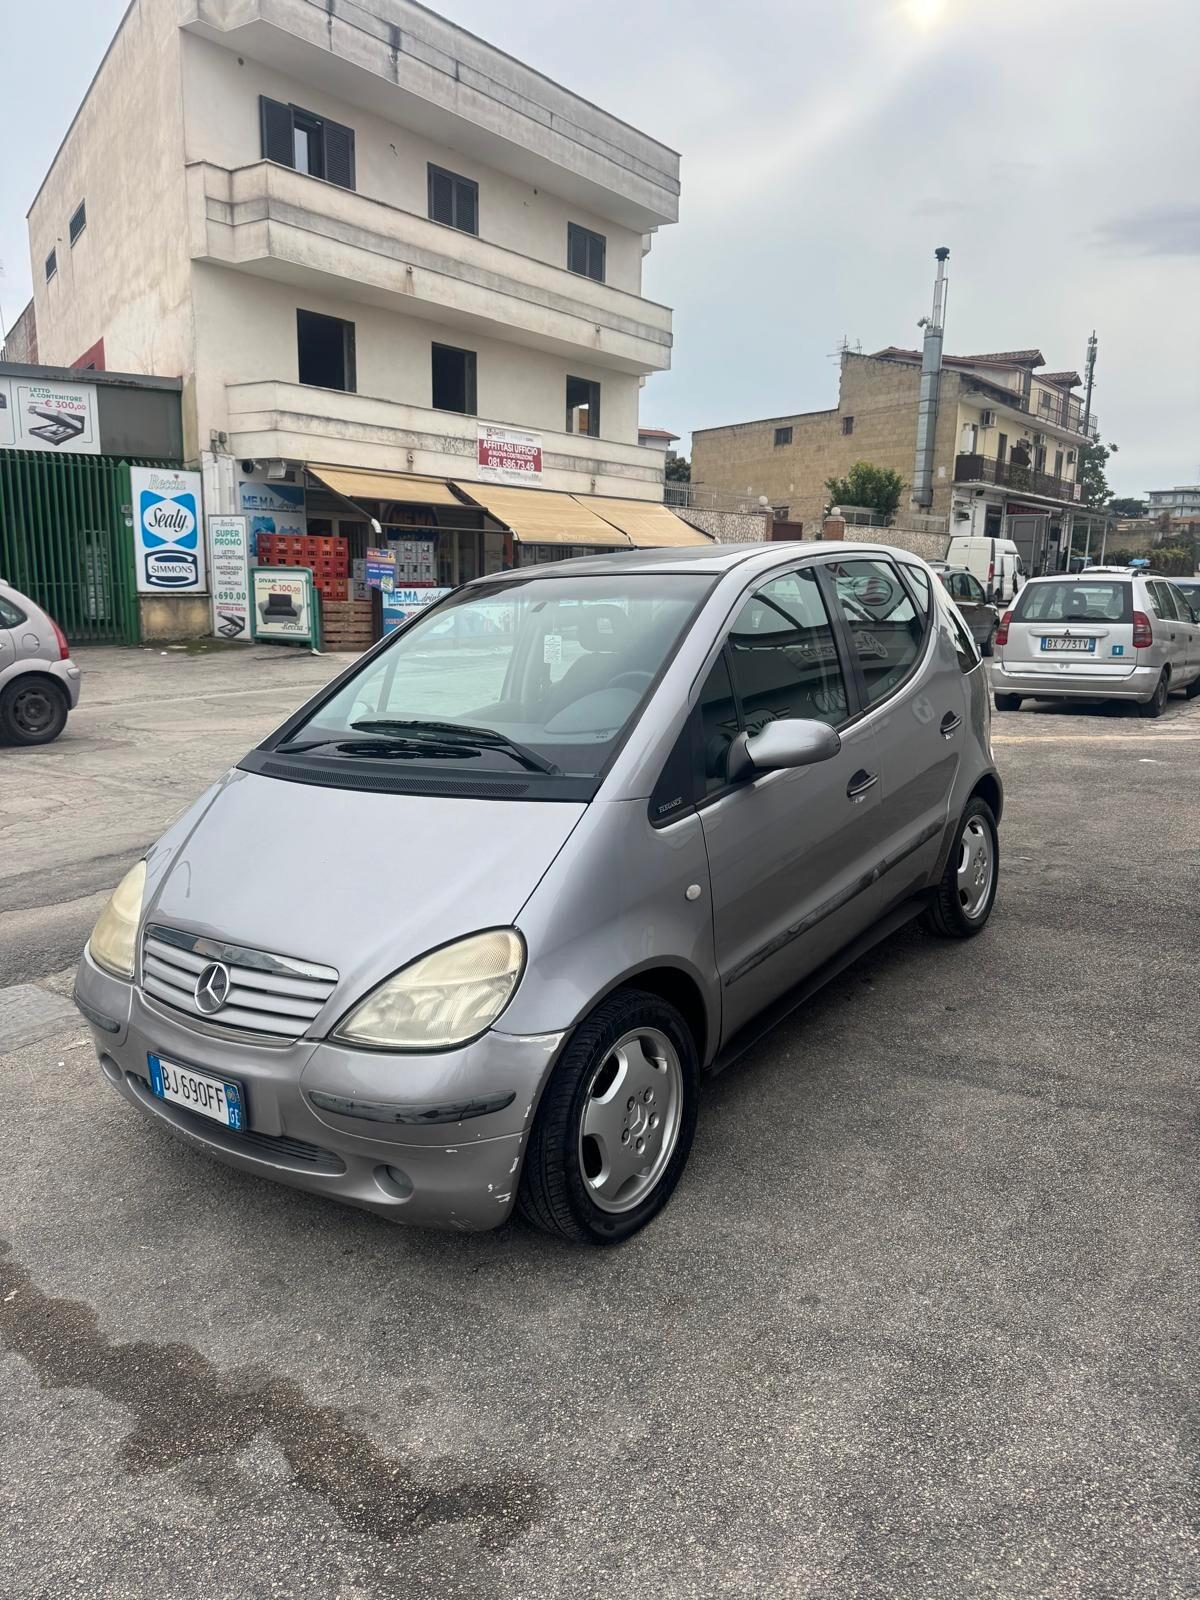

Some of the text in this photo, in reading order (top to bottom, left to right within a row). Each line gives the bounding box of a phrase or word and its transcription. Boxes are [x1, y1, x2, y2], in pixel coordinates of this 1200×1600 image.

[37, 393, 82, 402] CONTENITORE
[56, 401, 86, 411] 300,00
[483, 440, 538, 456] AFFITTASI UFFICIO
[507, 453, 533, 461] COSTRUZIONE
[149, 507, 187, 533] Sealy
[215, 538, 242, 546] PROMO
[151, 565, 193, 574] SIMMONS
[279, 585, 301, 593] 100,00
